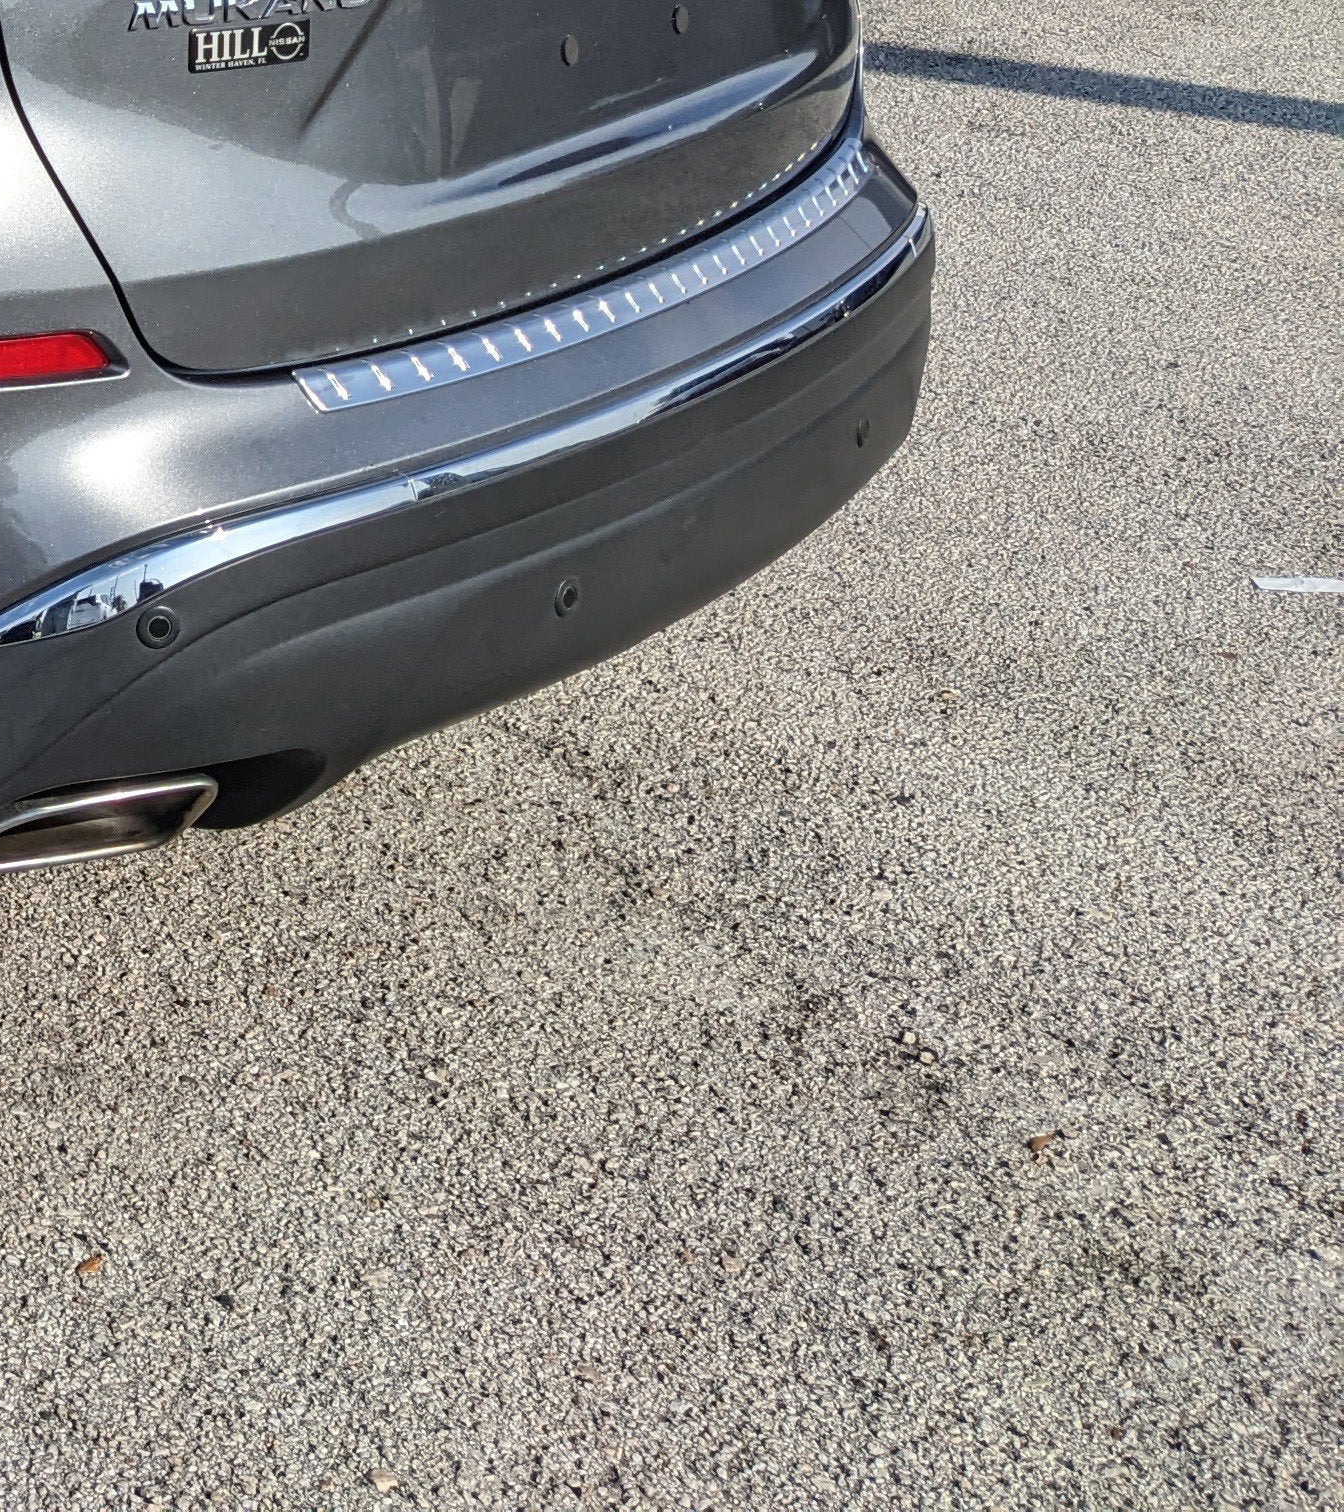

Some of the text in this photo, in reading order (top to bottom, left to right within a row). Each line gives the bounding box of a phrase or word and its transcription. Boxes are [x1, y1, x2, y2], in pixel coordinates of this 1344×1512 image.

[195, 27, 306, 64] HILL NISSAN
[195, 61, 226, 71] WINTER
[228, 58, 256, 67] HAVEN,
